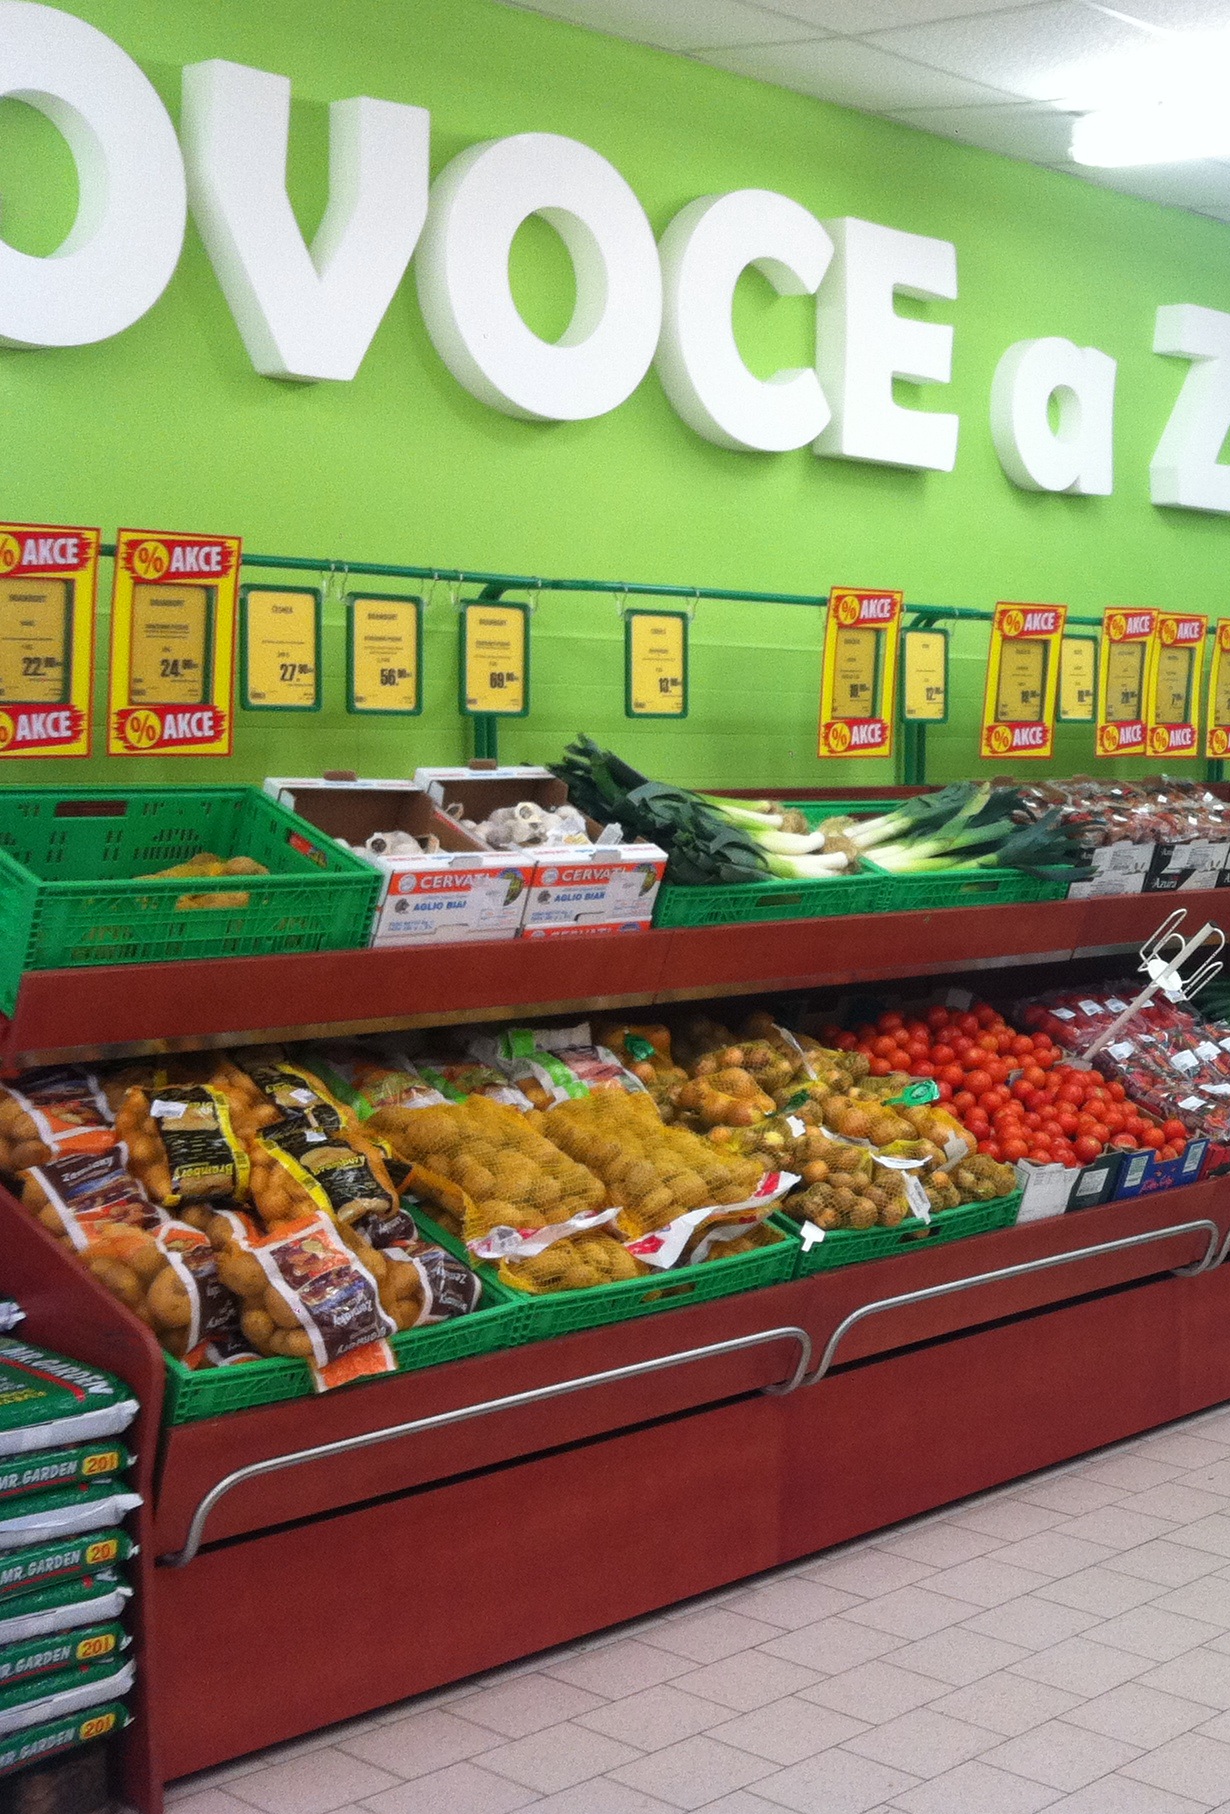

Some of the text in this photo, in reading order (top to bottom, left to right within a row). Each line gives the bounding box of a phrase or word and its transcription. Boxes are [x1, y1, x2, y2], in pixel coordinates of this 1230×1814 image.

[0, 0, 958, 473] OVOCE
[990, 336, 1116, 496] a
[22, 538, 79, 566] AKCE
[170, 546, 222, 573] AKCE
[860, 598, 891, 620] AKCE
[1024, 612, 1056, 632] AKCE
[1126, 615, 1150, 634] AKCE
[1177, 622, 1200, 640] AKCE
[16, 711, 72, 741] AKCE
[163, 711, 215, 740] AKCE
[850, 723, 882, 746] AKCE
[1119, 724, 1142, 745] AKCE
[1012, 726, 1043, 747] AKCE
[1169, 728, 1192, 747] AKCE
[413, 902, 444, 911] AGLIO
[172, 1162, 234, 1181] Brambory
